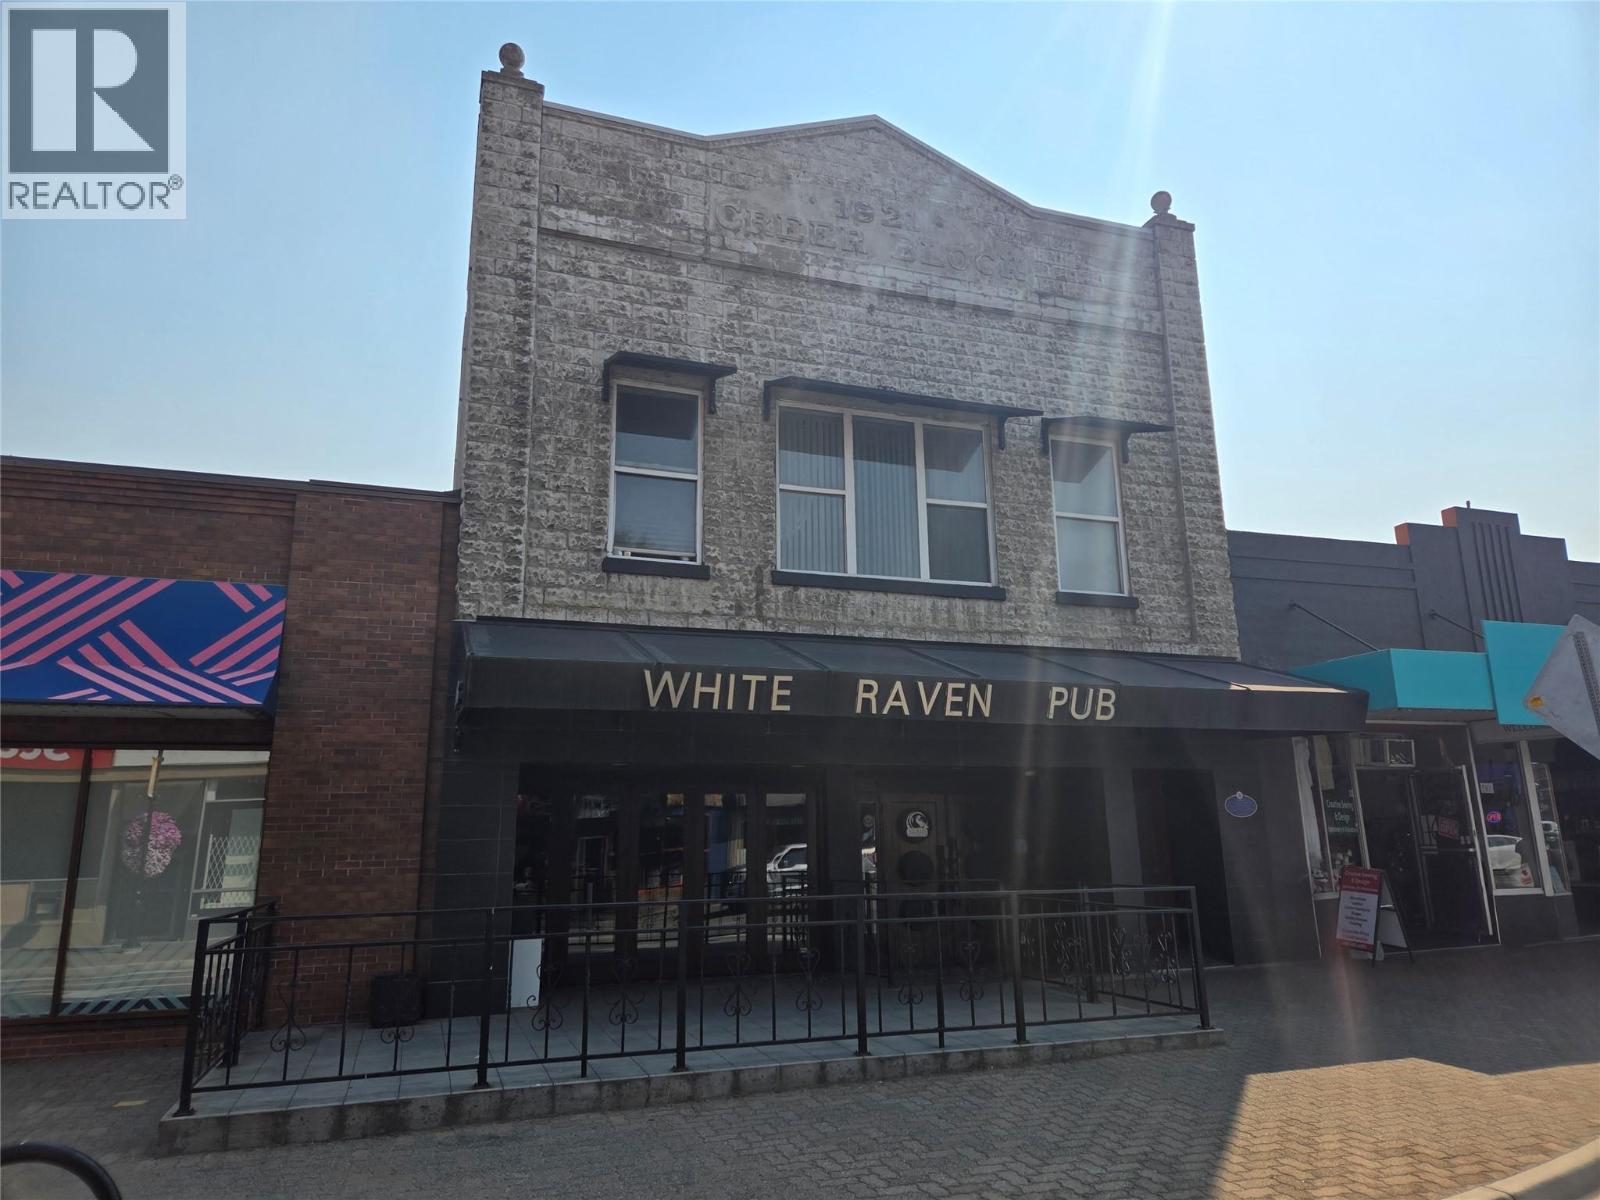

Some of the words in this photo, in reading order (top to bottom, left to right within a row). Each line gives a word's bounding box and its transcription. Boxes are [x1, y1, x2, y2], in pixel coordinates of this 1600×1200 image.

[643, 669, 794, 712] WHITE
[855, 678, 993, 718] RAVEN
[1048, 685, 1117, 721] PUB
